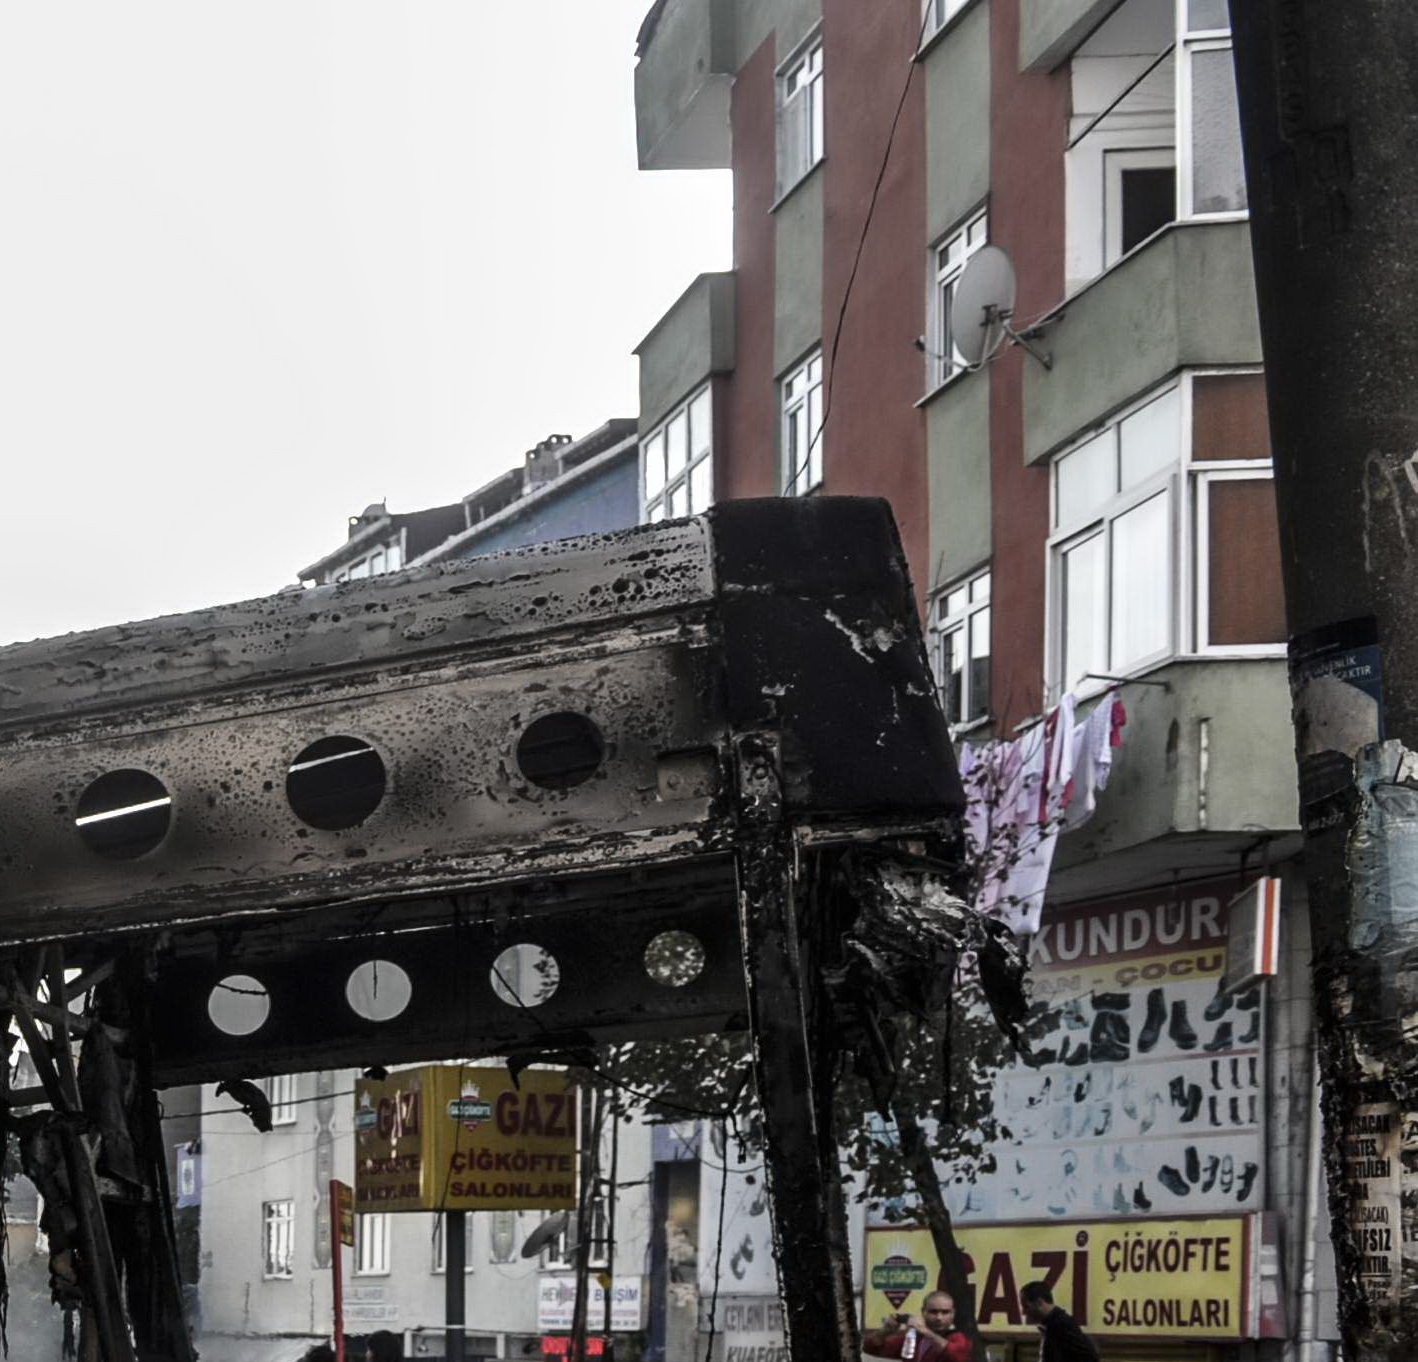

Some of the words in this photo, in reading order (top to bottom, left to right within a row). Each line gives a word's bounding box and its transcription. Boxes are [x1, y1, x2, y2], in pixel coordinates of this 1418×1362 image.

[1029, 895, 1228, 965] KUNDUR
[1115, 954, 1223, 989] ÇOCU
[451, 1148, 572, 1175] ÇİĞKÖFTE
[450, 1181, 572, 1199] SALONLARI
[1105, 1231, 1231, 1282] ÇİĞKÖFTE
[1103, 1298, 1230, 1328] SALONLARI
